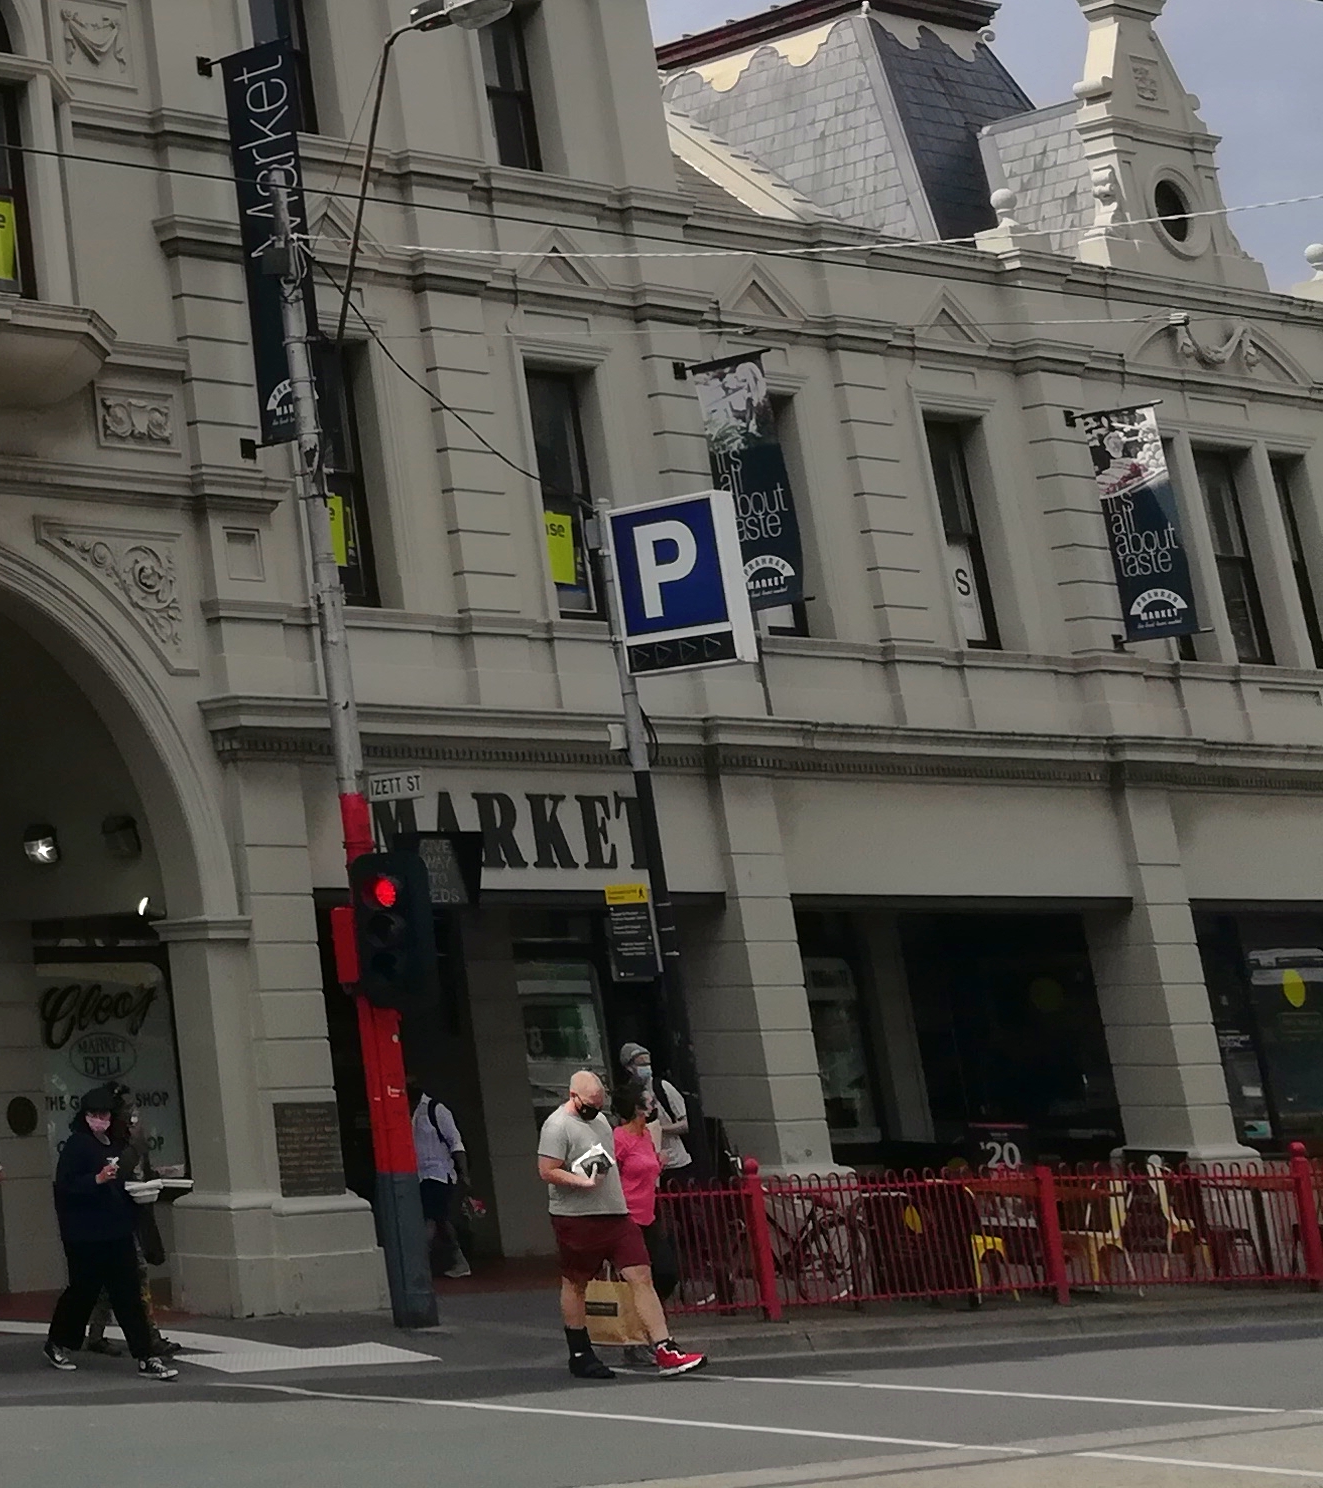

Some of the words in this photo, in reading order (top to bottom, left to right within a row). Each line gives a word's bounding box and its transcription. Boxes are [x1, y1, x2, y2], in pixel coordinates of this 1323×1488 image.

[735, 483, 789, 517] bout
[736, 510, 783, 542] aste
[1111, 505, 1135, 535] all
[1115, 521, 1179, 557] about
[632, 519, 697, 619] P
[1118, 549, 1172, 577] taste
[370, 777, 401, 796] IZETT
[407, 775, 421, 792] ST
[431, 888, 460, 903] EDS
[78, 1036, 126, 1053] MARKET
[83, 1055, 122, 1076] DELI
[135, 1092, 169, 1107] SHOP
